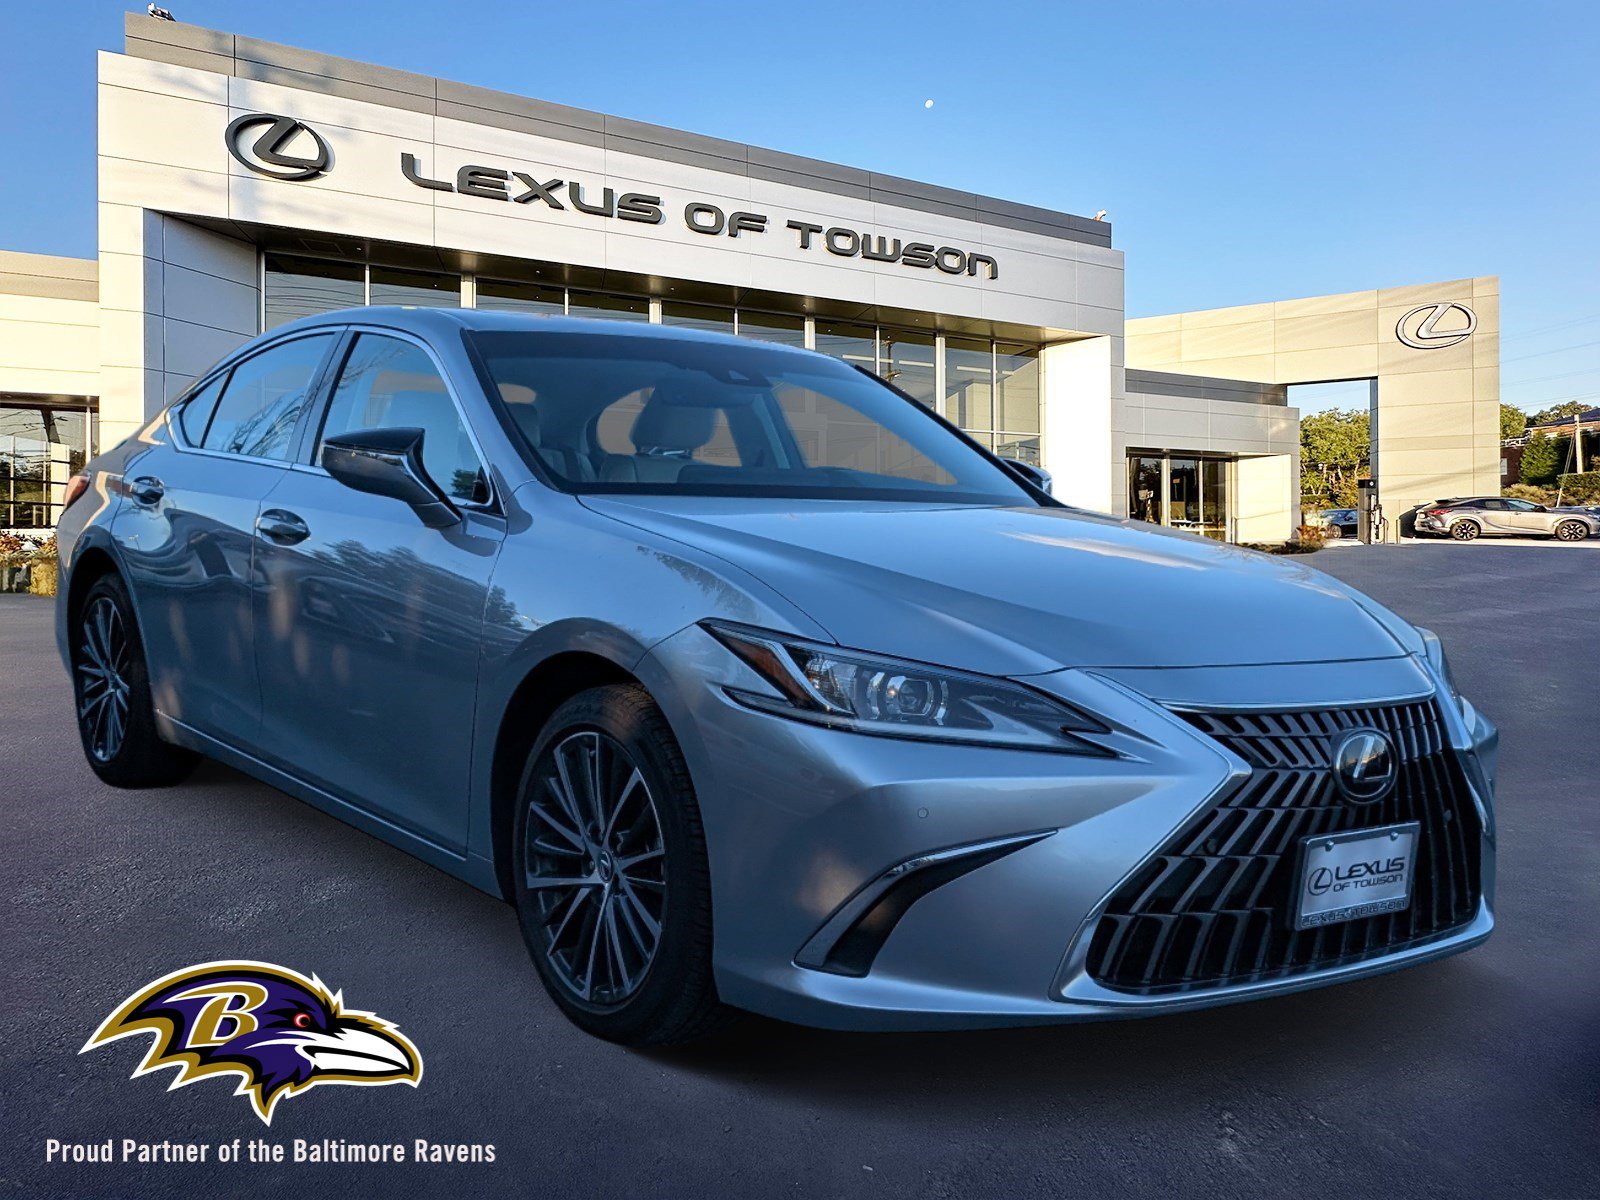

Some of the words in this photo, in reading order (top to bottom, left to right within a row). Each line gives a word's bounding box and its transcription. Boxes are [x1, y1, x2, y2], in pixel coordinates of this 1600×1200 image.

[401, 152, 662, 223] LEXUS
[685, 201, 768, 238] OF
[787, 219, 999, 280] TOWSON
[1335, 856, 1406, 880] LEXUS
[1333, 881, 1351, 893] OF
[1354, 874, 1404, 889] TOWSON
